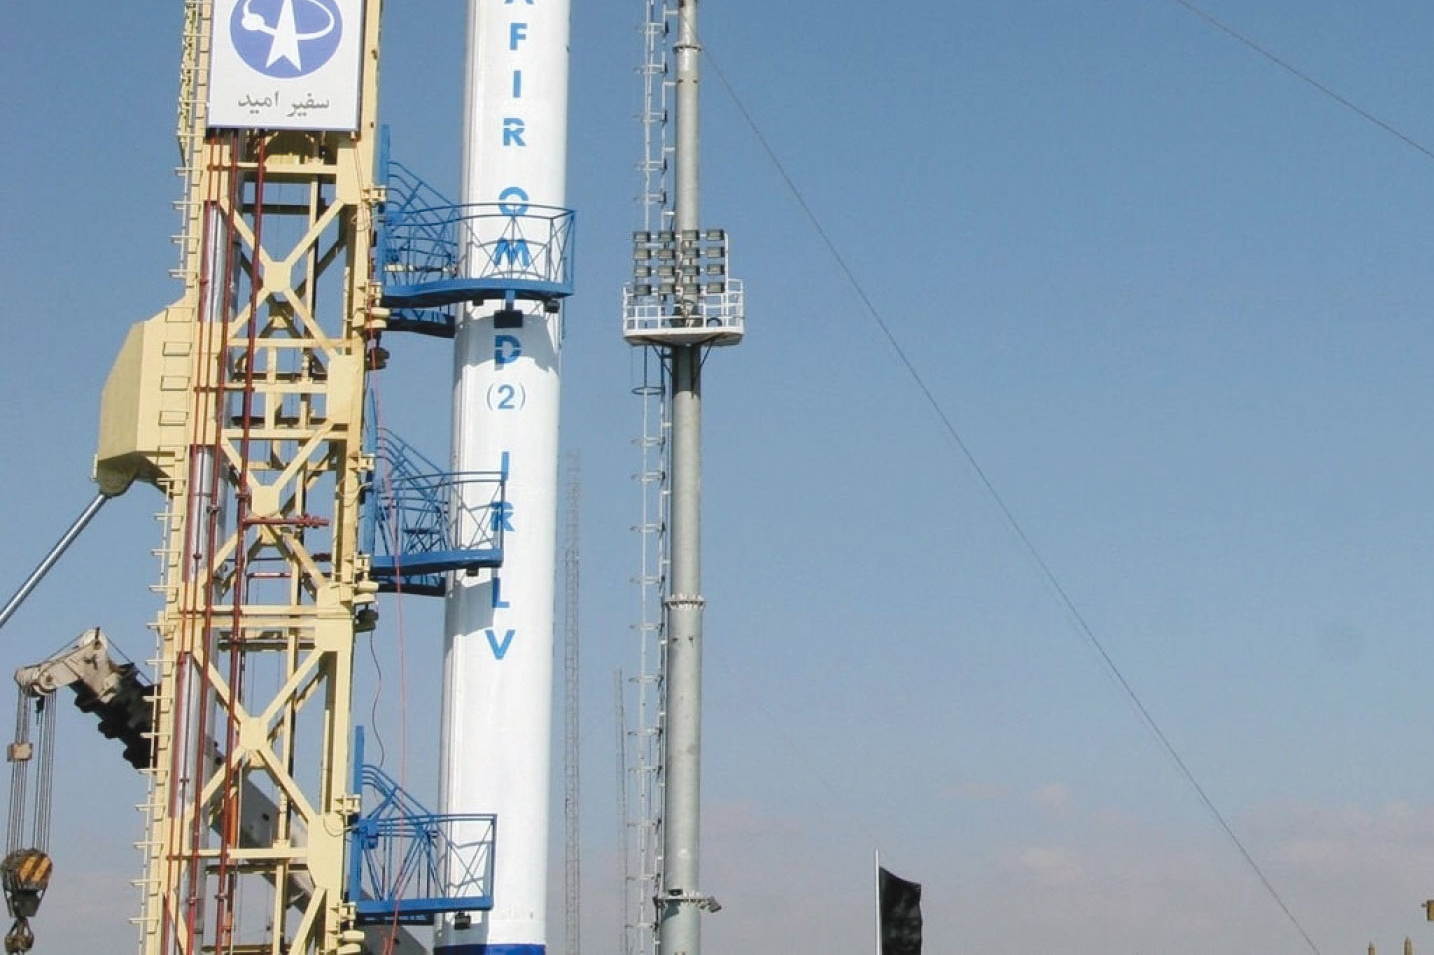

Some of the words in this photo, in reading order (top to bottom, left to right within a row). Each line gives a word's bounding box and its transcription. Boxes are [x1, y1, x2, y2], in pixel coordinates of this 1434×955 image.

[237, 90, 280, 114] امید
[286, 92, 330, 117] سفیر
[493, 186, 531, 364] OMD
[486, 383, 526, 410] (2)
